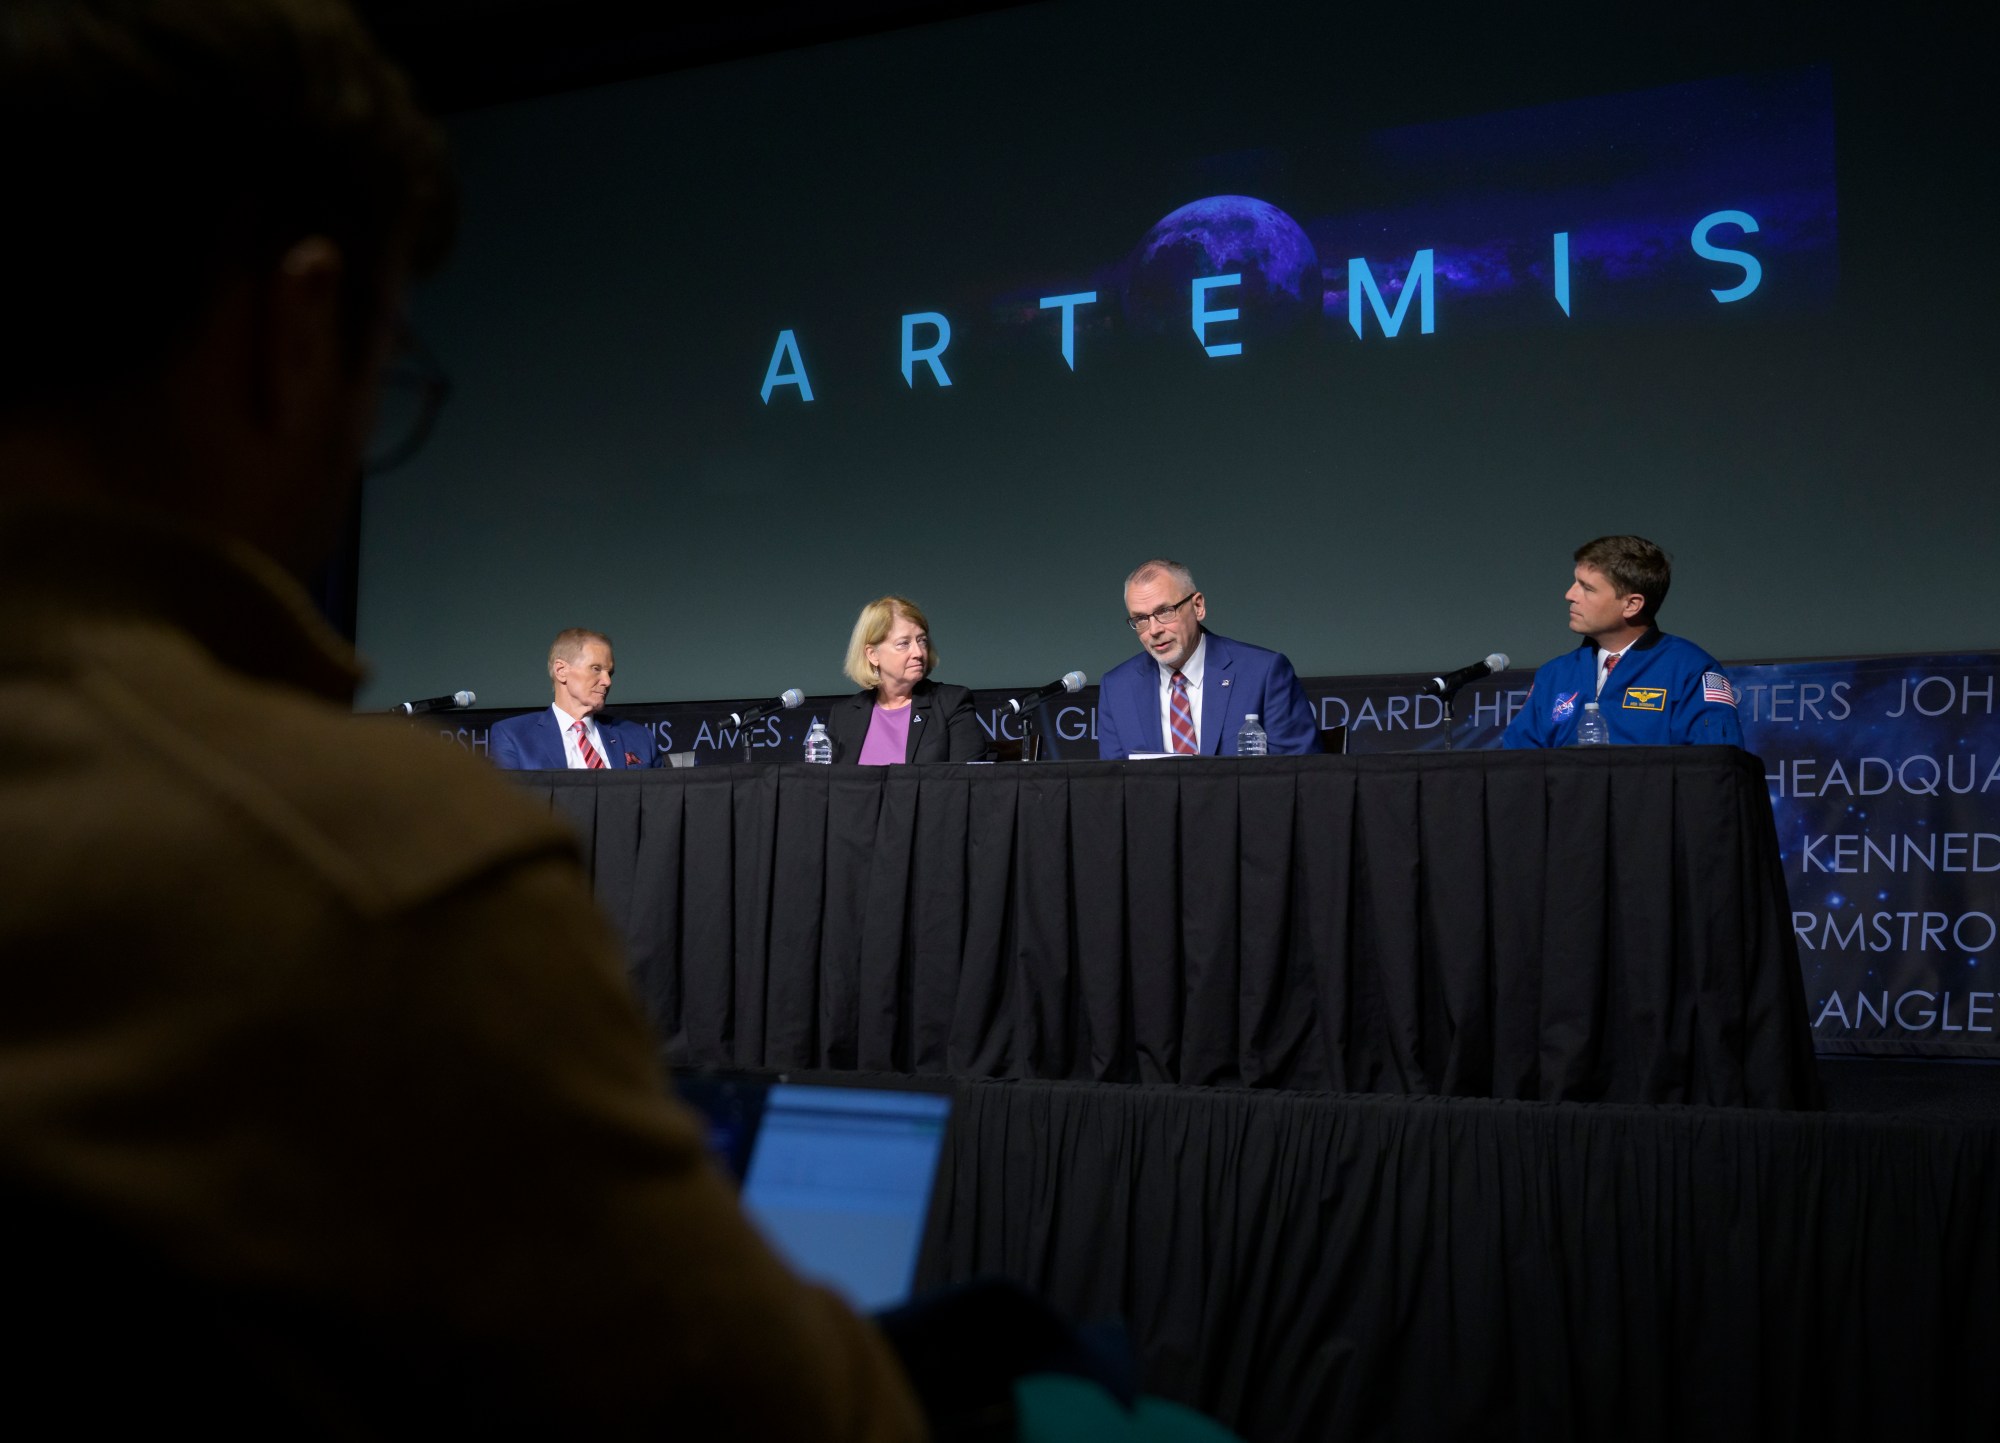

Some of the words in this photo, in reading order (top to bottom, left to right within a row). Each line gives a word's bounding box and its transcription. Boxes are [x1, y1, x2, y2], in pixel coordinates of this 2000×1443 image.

[759, 209, 1762, 404] ARTEMIS
[692, 715, 782, 750] AMES
[1055, 706, 1099, 741] GL
[1310, 694, 1443, 732] DARD
[1474, 690, 1529, 727] HE
[1733, 681, 1852, 722] TERS
[1886, 675, 1993, 717] JOH
[1803, 832, 2000, 874] KENNED
[1809, 989, 2000, 1033] ANGLE
